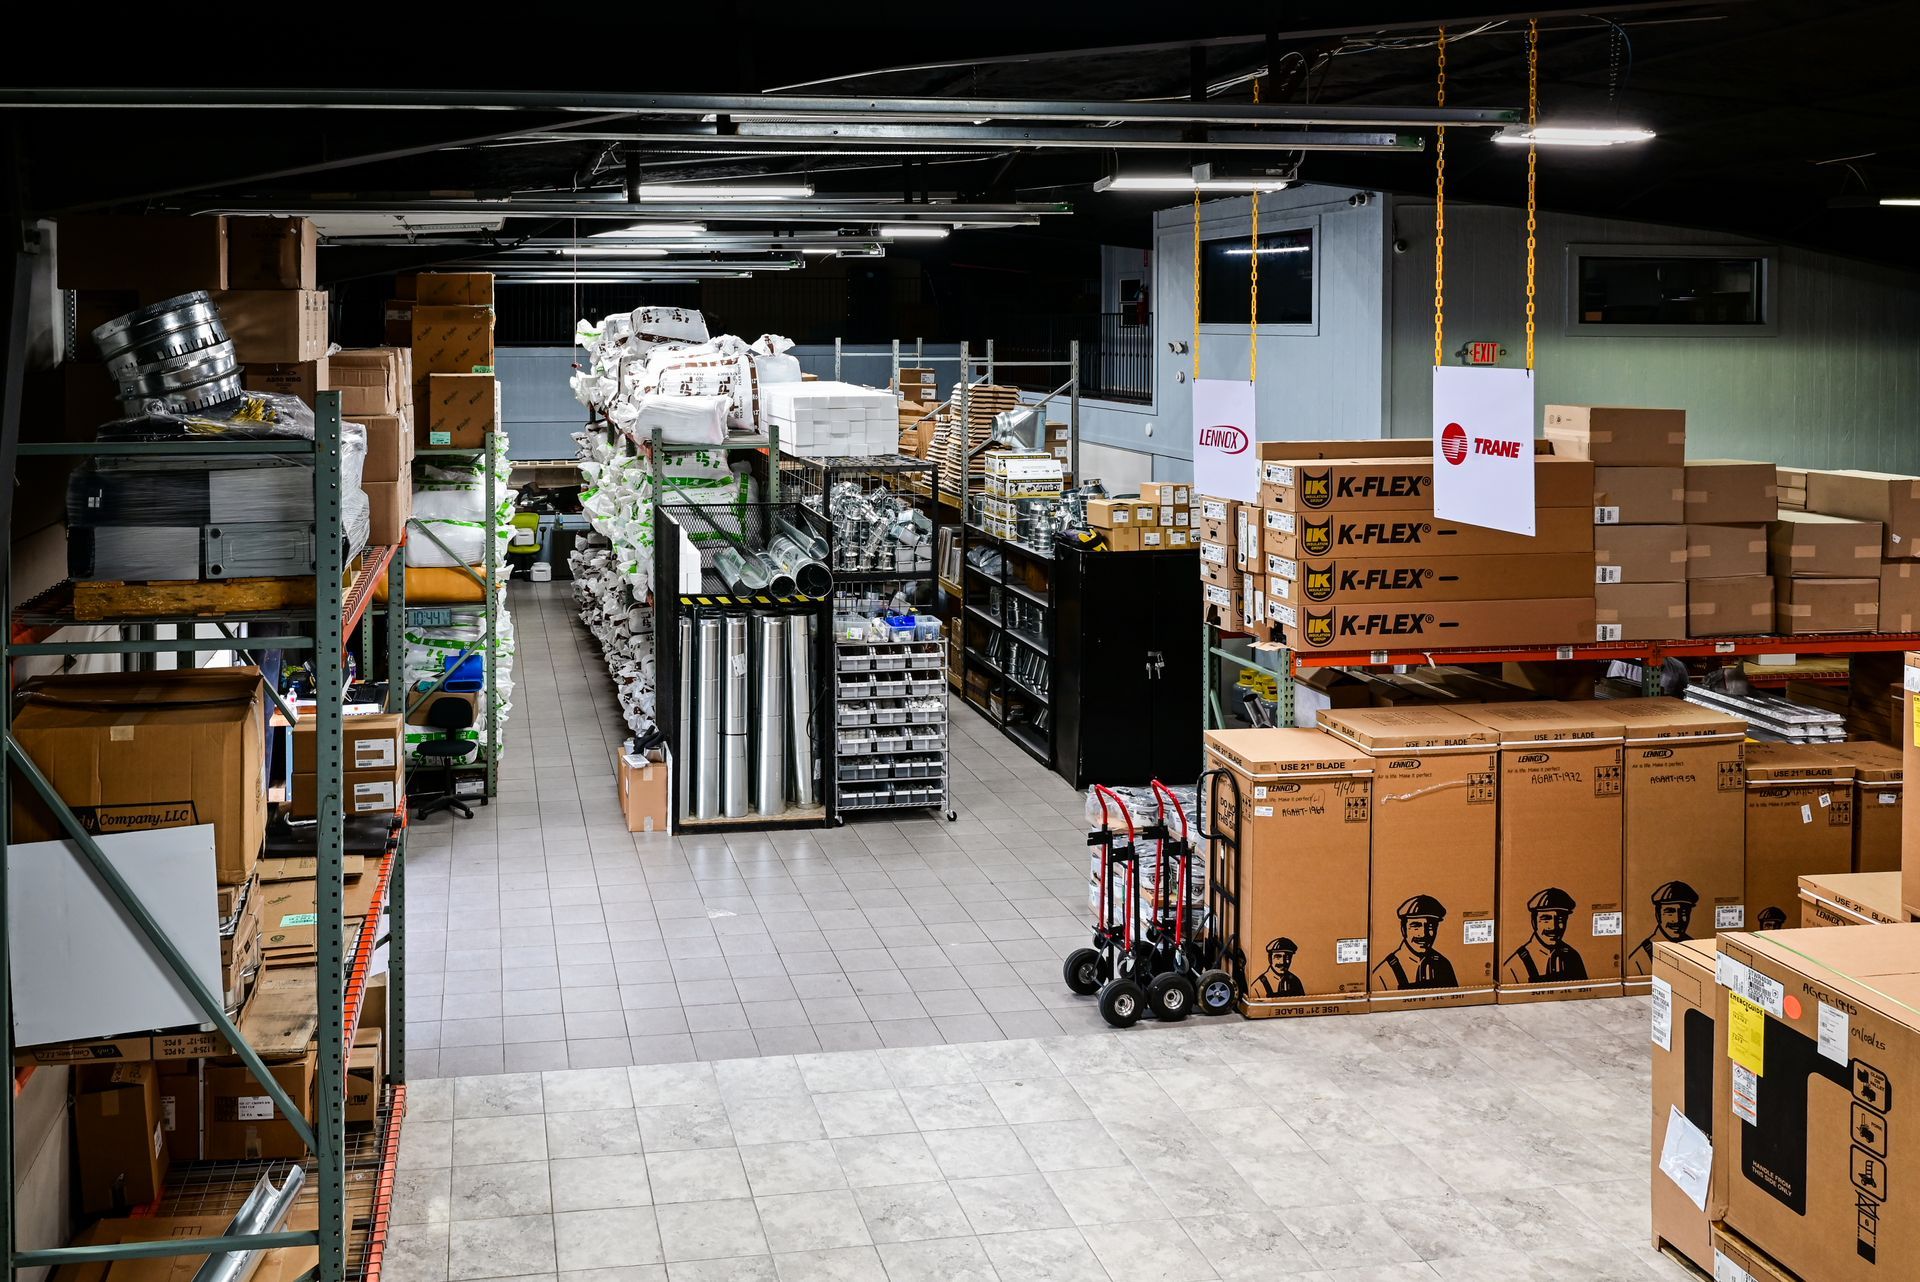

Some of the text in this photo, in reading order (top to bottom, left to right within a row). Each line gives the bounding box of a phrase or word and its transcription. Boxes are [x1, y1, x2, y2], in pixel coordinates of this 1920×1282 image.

[1473, 343, 1497, 363] EXIT
[1199, 428, 1239, 450] LENNOX
[1474, 438, 1521, 458] TRANE
[1305, 480, 1328, 495] IK
[1306, 527, 1328, 542] IK
[1308, 574, 1330, 588] IK
[413, 611, 441, 625] 10:44
[1308, 619, 1331, 633] IK
[1342, 726, 1355, 738] BLADE
[1228, 752, 1243, 766] BLADE
[1518, 755, 1544, 763] LENNOX
[1643, 750, 1669, 758] LENNOX
[1268, 784, 1296, 793] LENNOX
[1220, 797, 1227, 808] DO
[1217, 812, 1229, 826] THIS
[1835, 896, 1897, 923] USE 21" BLAD
[1816, 910, 1841, 926] LENNOX
[1752, 1160, 1791, 1190] HANDLE FROM
[1752, 1166, 1792, 1196] THIS SIDE ONLY
